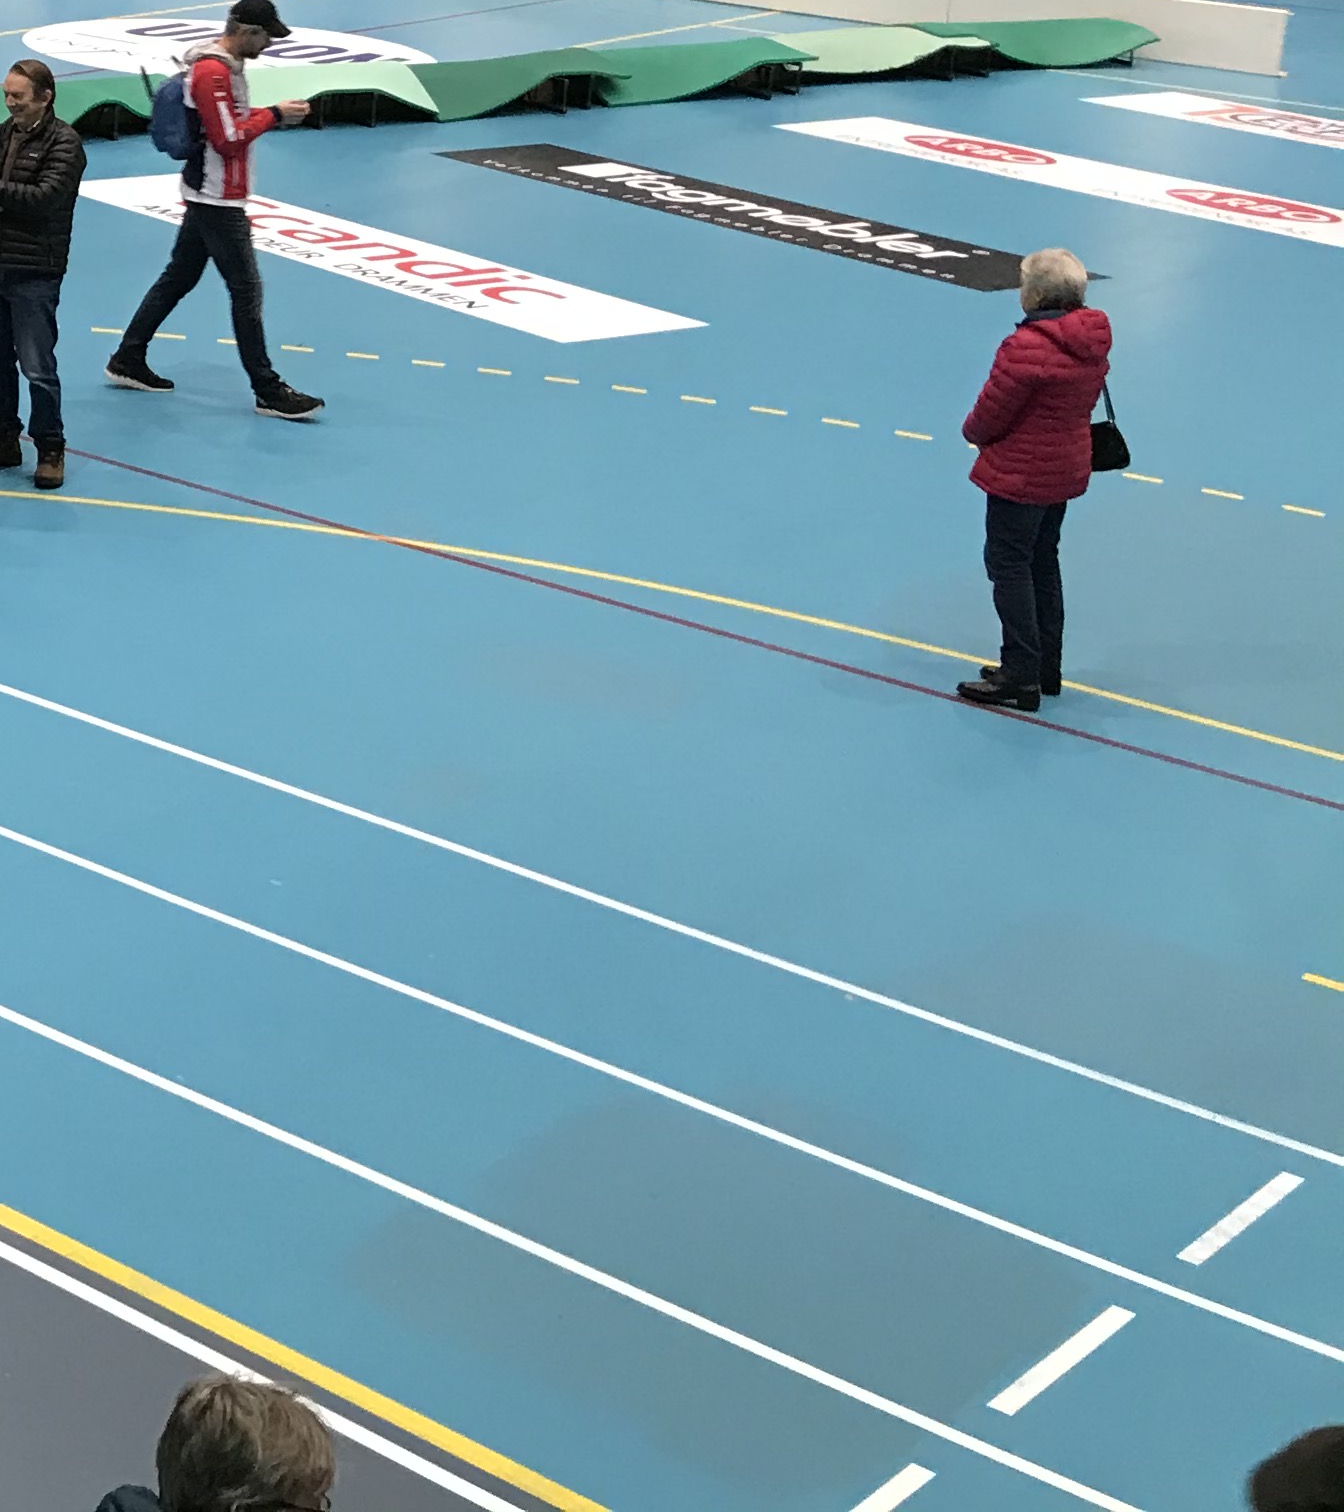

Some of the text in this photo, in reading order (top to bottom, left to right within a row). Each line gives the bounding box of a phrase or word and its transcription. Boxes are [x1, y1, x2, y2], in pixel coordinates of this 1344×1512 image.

[919, 135, 1050, 165] ARBO
[1182, 190, 1331, 224] ARBO
[250, 195, 567, 305] candic
[333, 262, 489, 311] DRAMMEN
